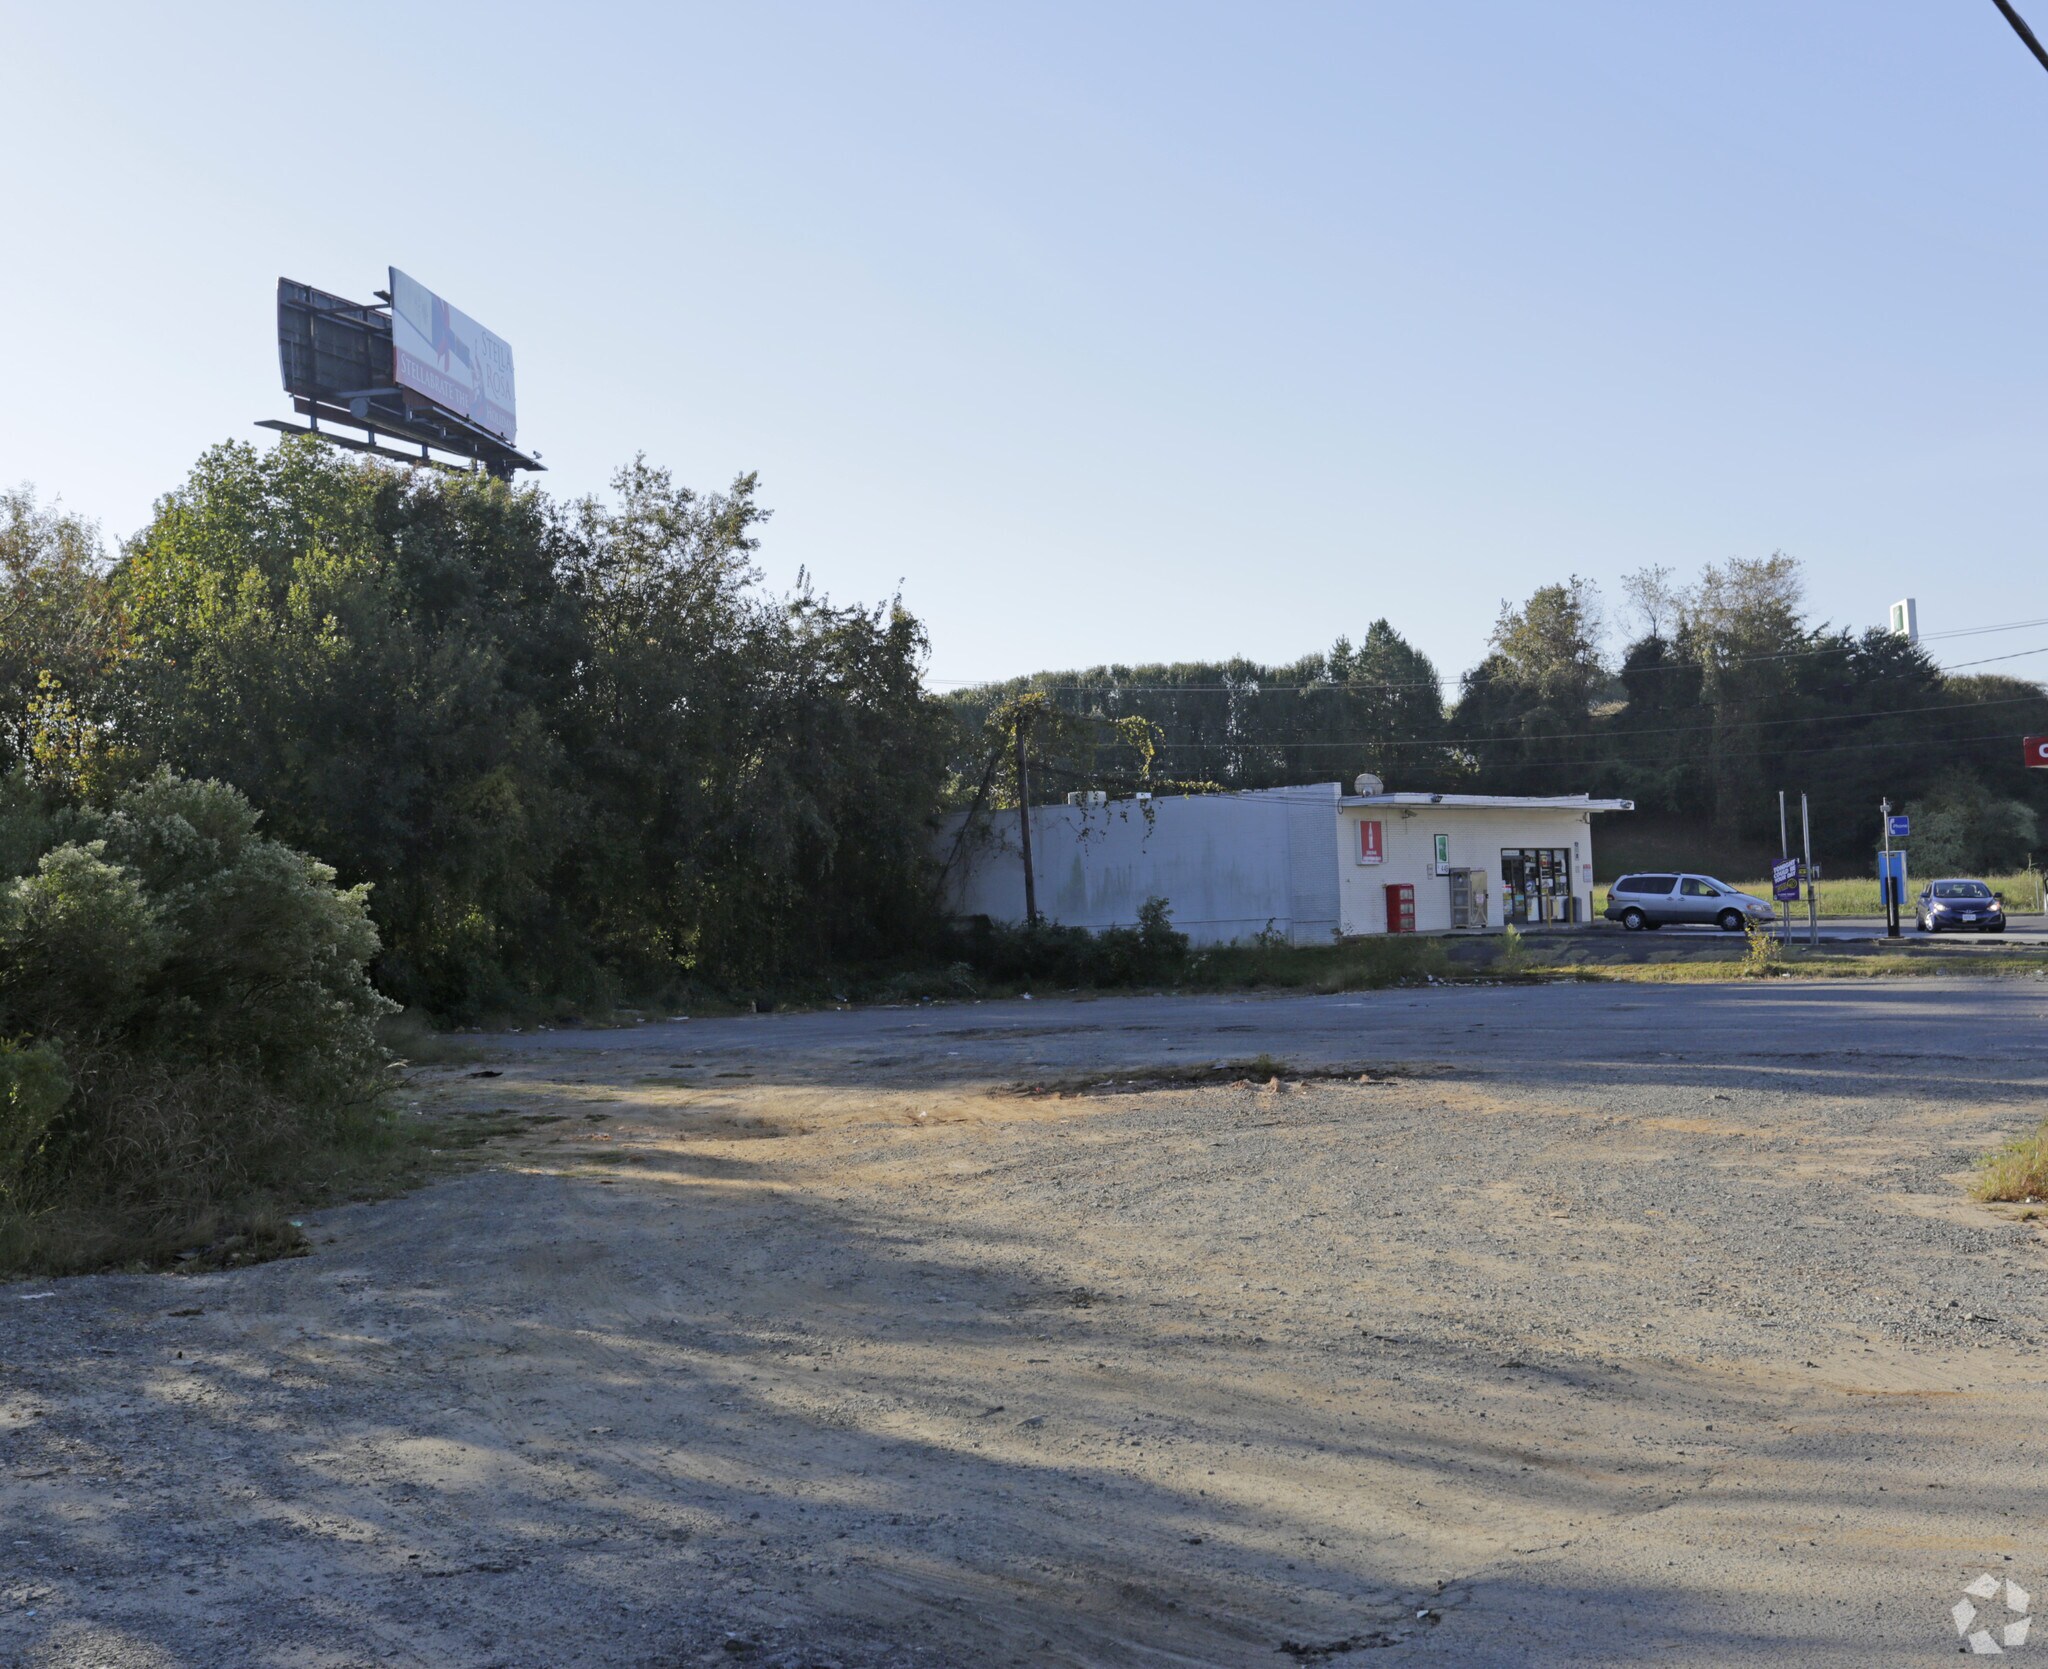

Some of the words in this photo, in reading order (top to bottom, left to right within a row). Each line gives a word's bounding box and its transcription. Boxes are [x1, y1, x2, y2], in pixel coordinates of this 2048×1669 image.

[481, 331, 513, 373] STELLA
[400, 353, 453, 400] STELLABRATE
[455, 387, 469, 408] THE
[487, 363, 511, 400] ROSA
